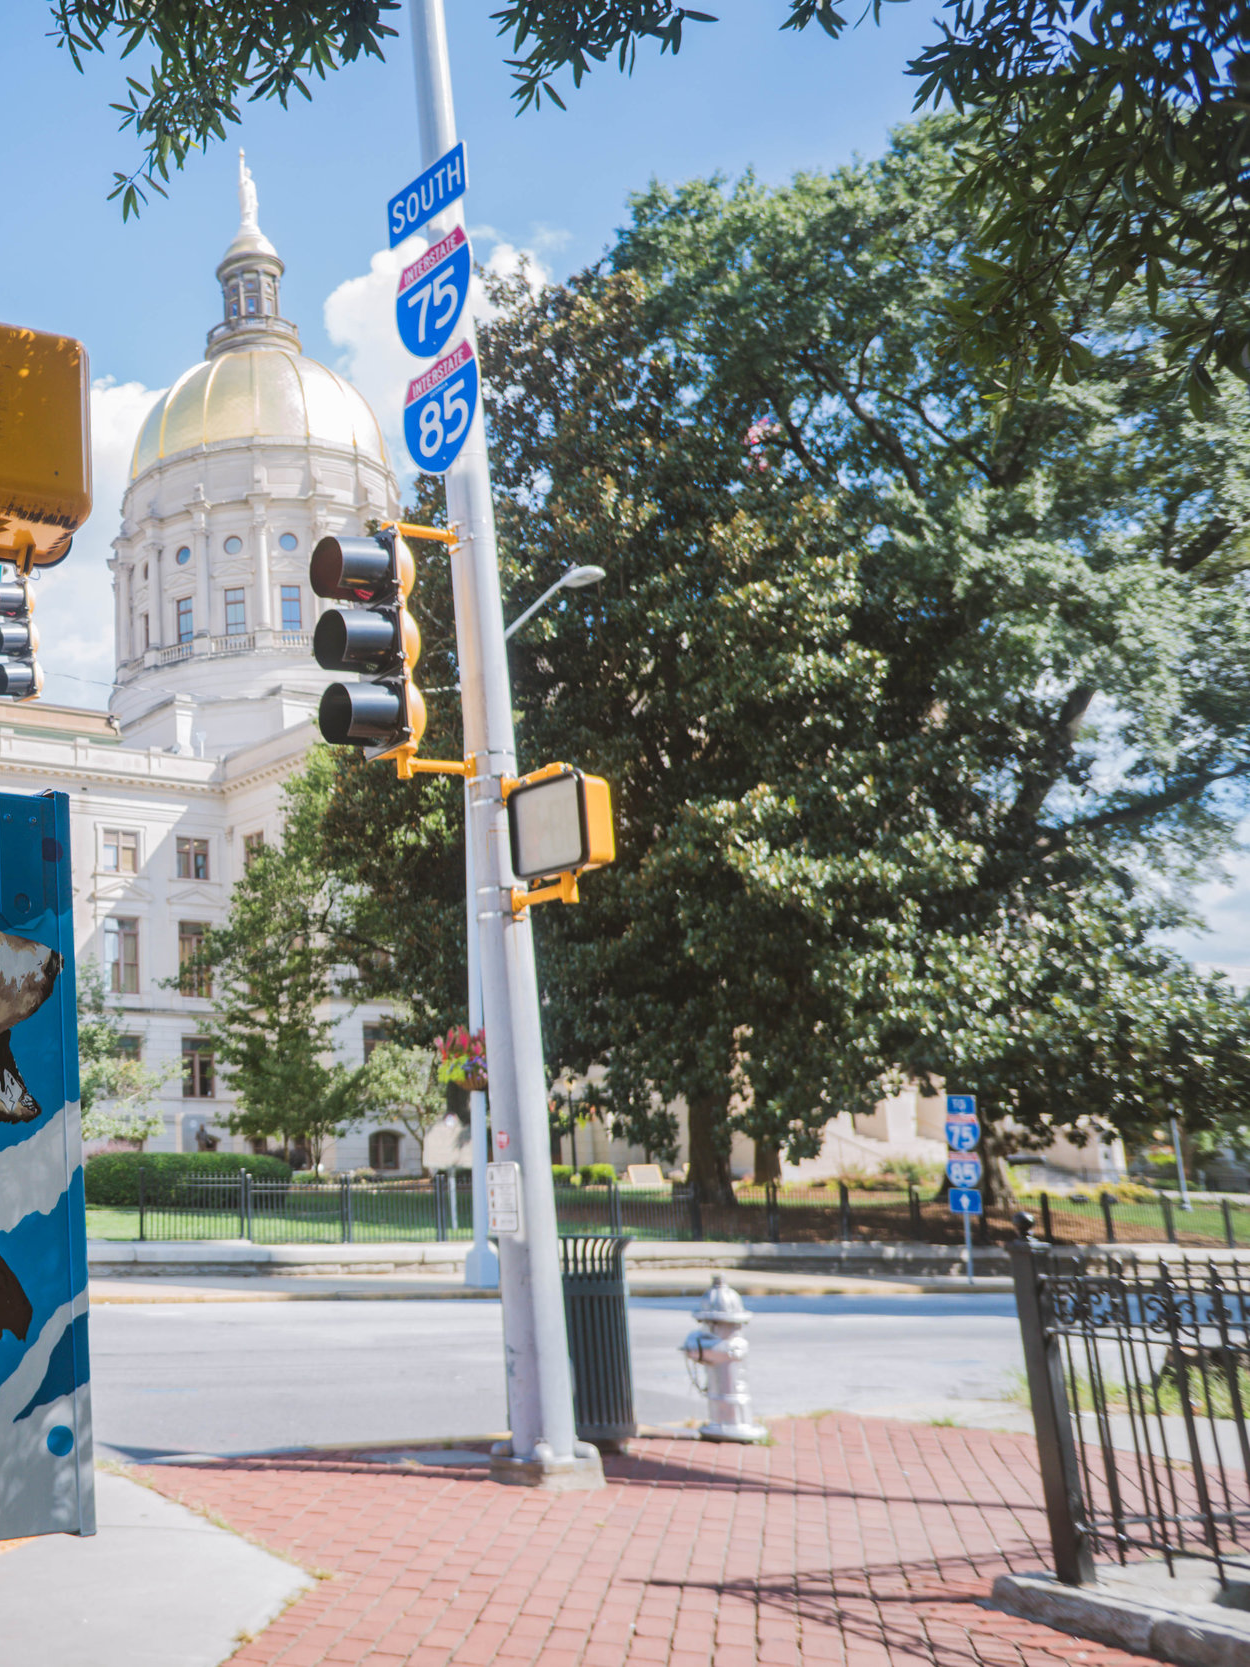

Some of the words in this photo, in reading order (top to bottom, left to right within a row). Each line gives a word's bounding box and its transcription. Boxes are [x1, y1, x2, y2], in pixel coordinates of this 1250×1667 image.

[392, 156, 461, 234] SOUTH
[403, 233, 457, 286] INTERSTATE
[407, 264, 458, 344] 75
[411, 347, 465, 399] INTERSTATE
[419, 378, 469, 458] 85
[948, 1125, 975, 1149] 75
[950, 1163, 977, 1187] 85
